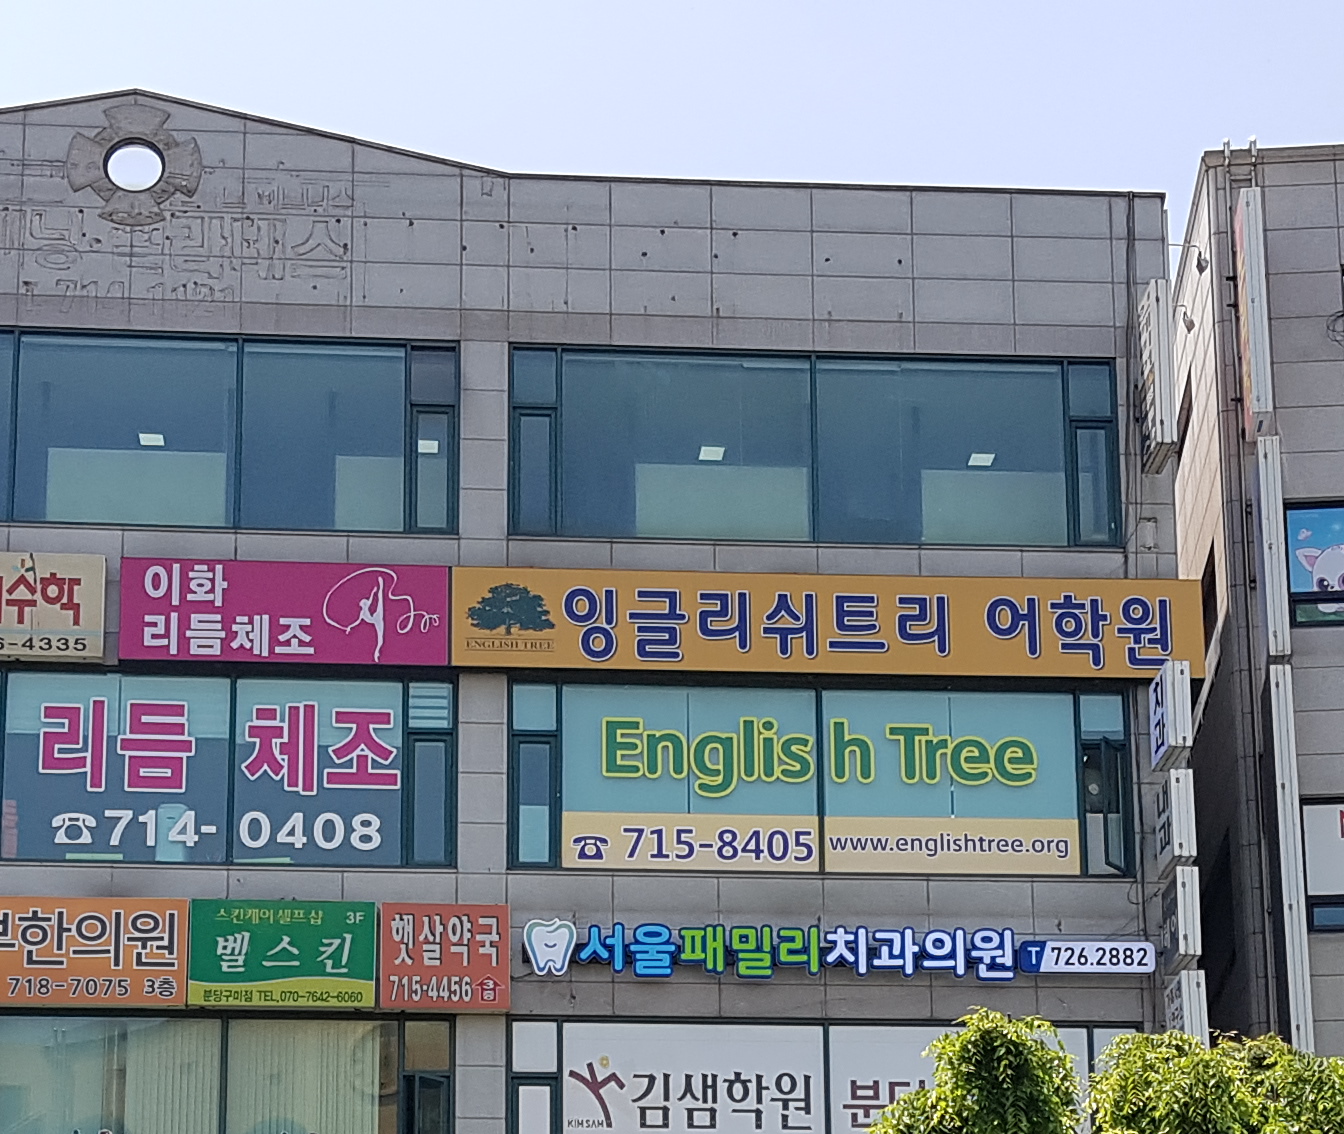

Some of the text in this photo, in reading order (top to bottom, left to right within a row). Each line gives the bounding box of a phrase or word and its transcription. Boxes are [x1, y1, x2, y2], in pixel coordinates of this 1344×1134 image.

[143, 563, 227, 607] 이화
[143, 613, 315, 657] 리듬체조
[465, 639, 515, 651] ENGLISH
[562, 585, 1174, 669] 잉글리쉬트리 어학원
[1151, 681, 1169, 757] 치과
[38, 698, 196, 793] 리듬
[241, 701, 401, 795] 체조
[601, 716, 1039, 798] English Tree
[1156, 780, 1173, 856] 내과
[621, 826, 1071, 864] 715-8405 www.englishtree.org
[346, 912, 365, 923] 3F
[390, 914, 501, 967] 햇살약국
[215, 931, 353, 974] 벨스킨
[578, 922, 1149, 981] 서울패밀리치과의원 T 726.2882
[7, 977, 176, 1001] 718-7075 3층
[203, 990, 254, 1003] 분당구미점
[630, 1071, 814, 1132] 김샘학원
